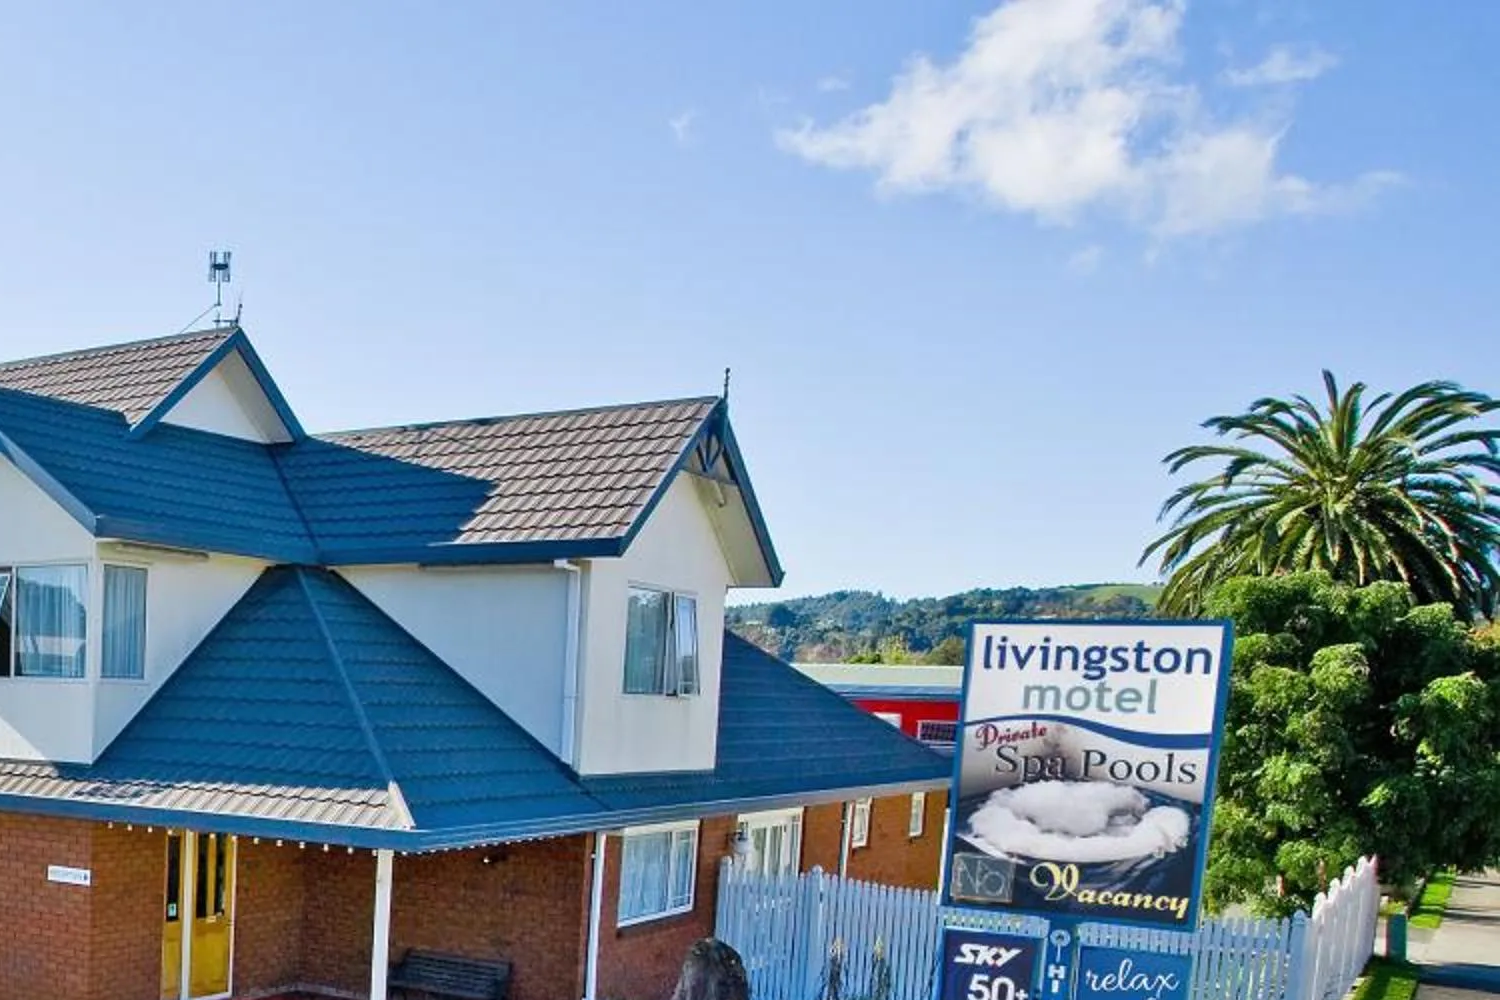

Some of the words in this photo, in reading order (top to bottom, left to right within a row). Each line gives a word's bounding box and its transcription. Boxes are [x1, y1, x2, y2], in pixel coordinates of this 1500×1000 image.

[983, 635, 1213, 681] livingston
[1022, 679, 1158, 714] motel
[975, 721, 1048, 751] Private
[995, 745, 1067, 782] Spa
[1081, 750, 1197, 785] Pools
[1029, 862, 1190, 919] Vacancy
[953, 943, 1023, 967] SKY
[1086, 958, 1179, 999] relax
